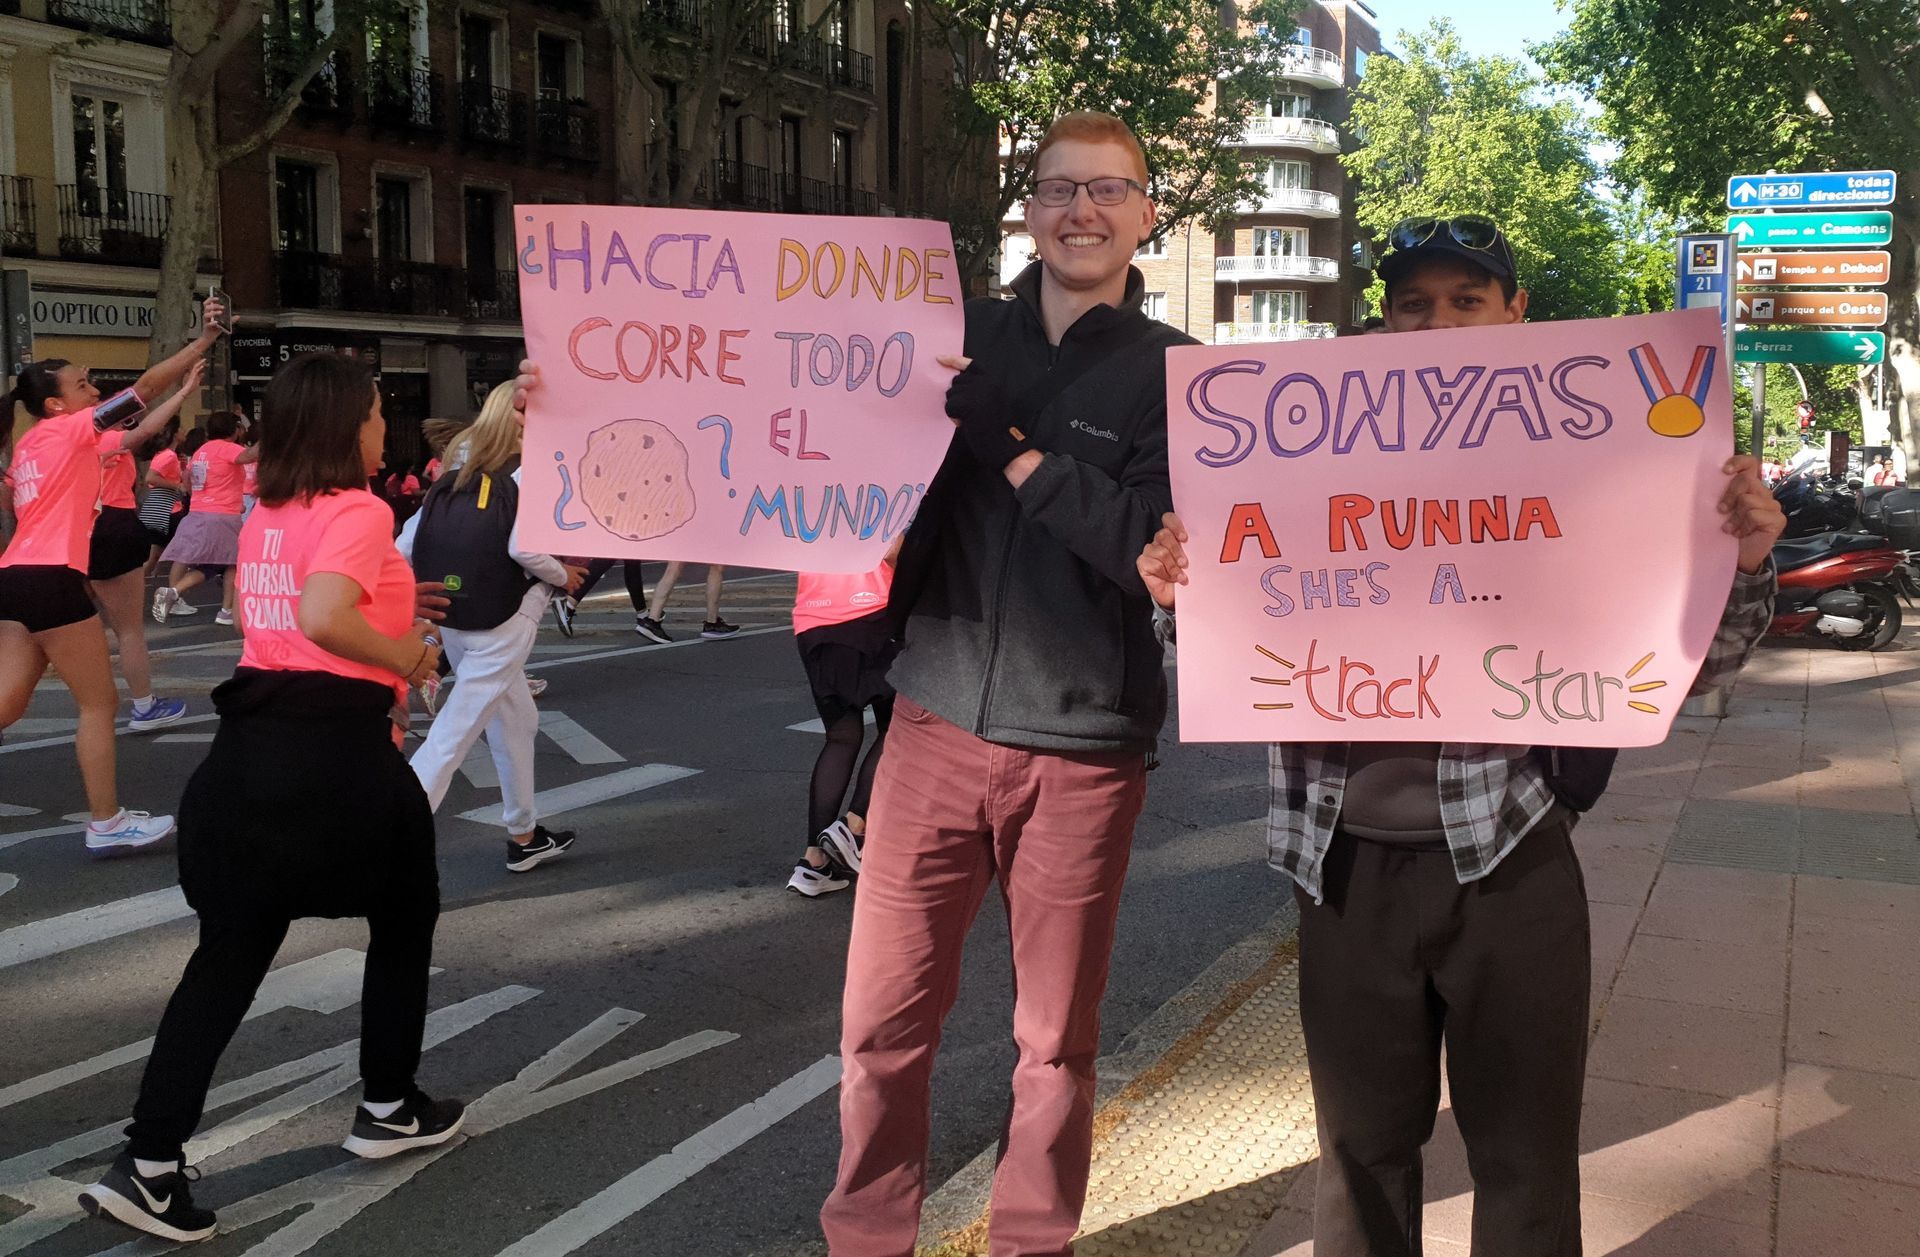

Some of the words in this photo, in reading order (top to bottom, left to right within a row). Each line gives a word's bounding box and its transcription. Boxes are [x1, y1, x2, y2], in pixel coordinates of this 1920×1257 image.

[1761, 184, 1800, 198] M-30
[1848, 176, 1891, 189] todas
[1808, 189, 1890, 202] direcciones
[1803, 227, 1815, 235] de
[1821, 222, 1887, 235] Camoens
[776, 238, 954, 305] DONDE
[1781, 265, 1817, 275] templo
[1822, 265, 1836, 274] de
[1840, 263, 1884, 274] Debod
[1696, 276, 1711, 291] 21
[51, 302, 118, 326] OPTICO
[1819, 305, 1835, 314] del
[1839, 303, 1882, 315] Oeste
[279, 345, 290, 362] 5
[568, 317, 750, 387] CORRE
[774, 331, 915, 398] TODO
[1754, 341, 1793, 352] Ferraz
[259, 356, 271, 367] 35
[1186, 355, 1614, 468] SONYA'S
[769, 407, 831, 461] EL
[1079, 421, 1119, 442] Columbia
[1219, 502, 1282, 563] A
[1328, 494, 1563, 553] RUNNA
[262, 528, 284, 561] TU
[240, 562, 303, 596] DORSAL
[1260, 561, 1391, 618] SHE'S
[243, 597, 297, 631] SUMA
[1481, 644, 1624, 725] Star
